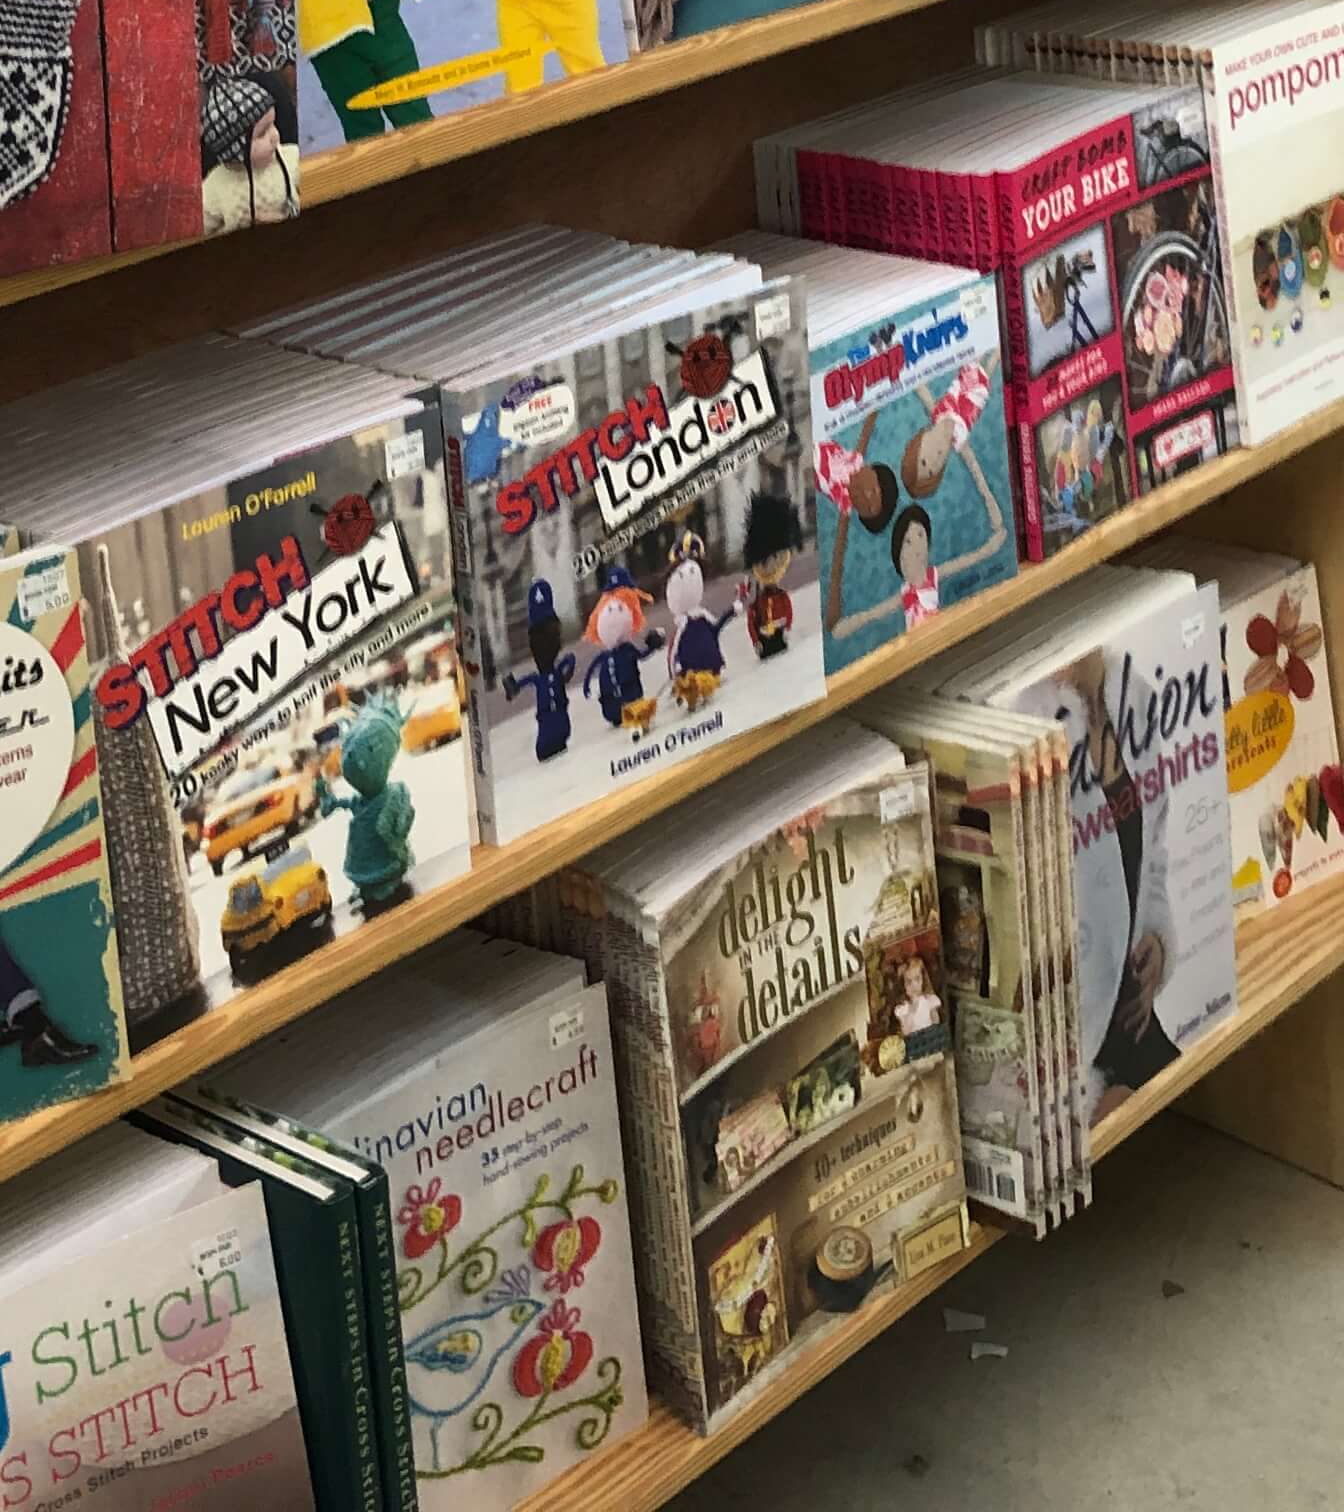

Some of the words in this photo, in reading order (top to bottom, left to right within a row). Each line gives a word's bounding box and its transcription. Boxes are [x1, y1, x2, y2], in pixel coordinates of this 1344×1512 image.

[1021, 182, 1079, 240] YOUR
[1081, 157, 1132, 210] BIKE
[494, 382, 671, 535] STITCH
[528, 394, 553, 412] FREE
[599, 381, 765, 511] London
[182, 506, 240, 541] Lauren
[244, 472, 317, 517] O'Farrell
[94, 535, 311, 730] STITCH
[165, 635, 279, 756] New
[283, 555, 393, 650] York
[609, 739, 662, 778] Lauren
[664, 711, 724, 753] O'Farrell
[1071, 730, 1221, 857] sweatshirts
[717, 826, 855, 959] delight
[739, 943, 754, 971] IN
[757, 932, 780, 958] THE
[737, 923, 865, 1045] details
[415, 1042, 600, 1176] needlecraft
[30, 1265, 250, 1404] Stitch
[46, 1344, 265, 1482] STITCH
